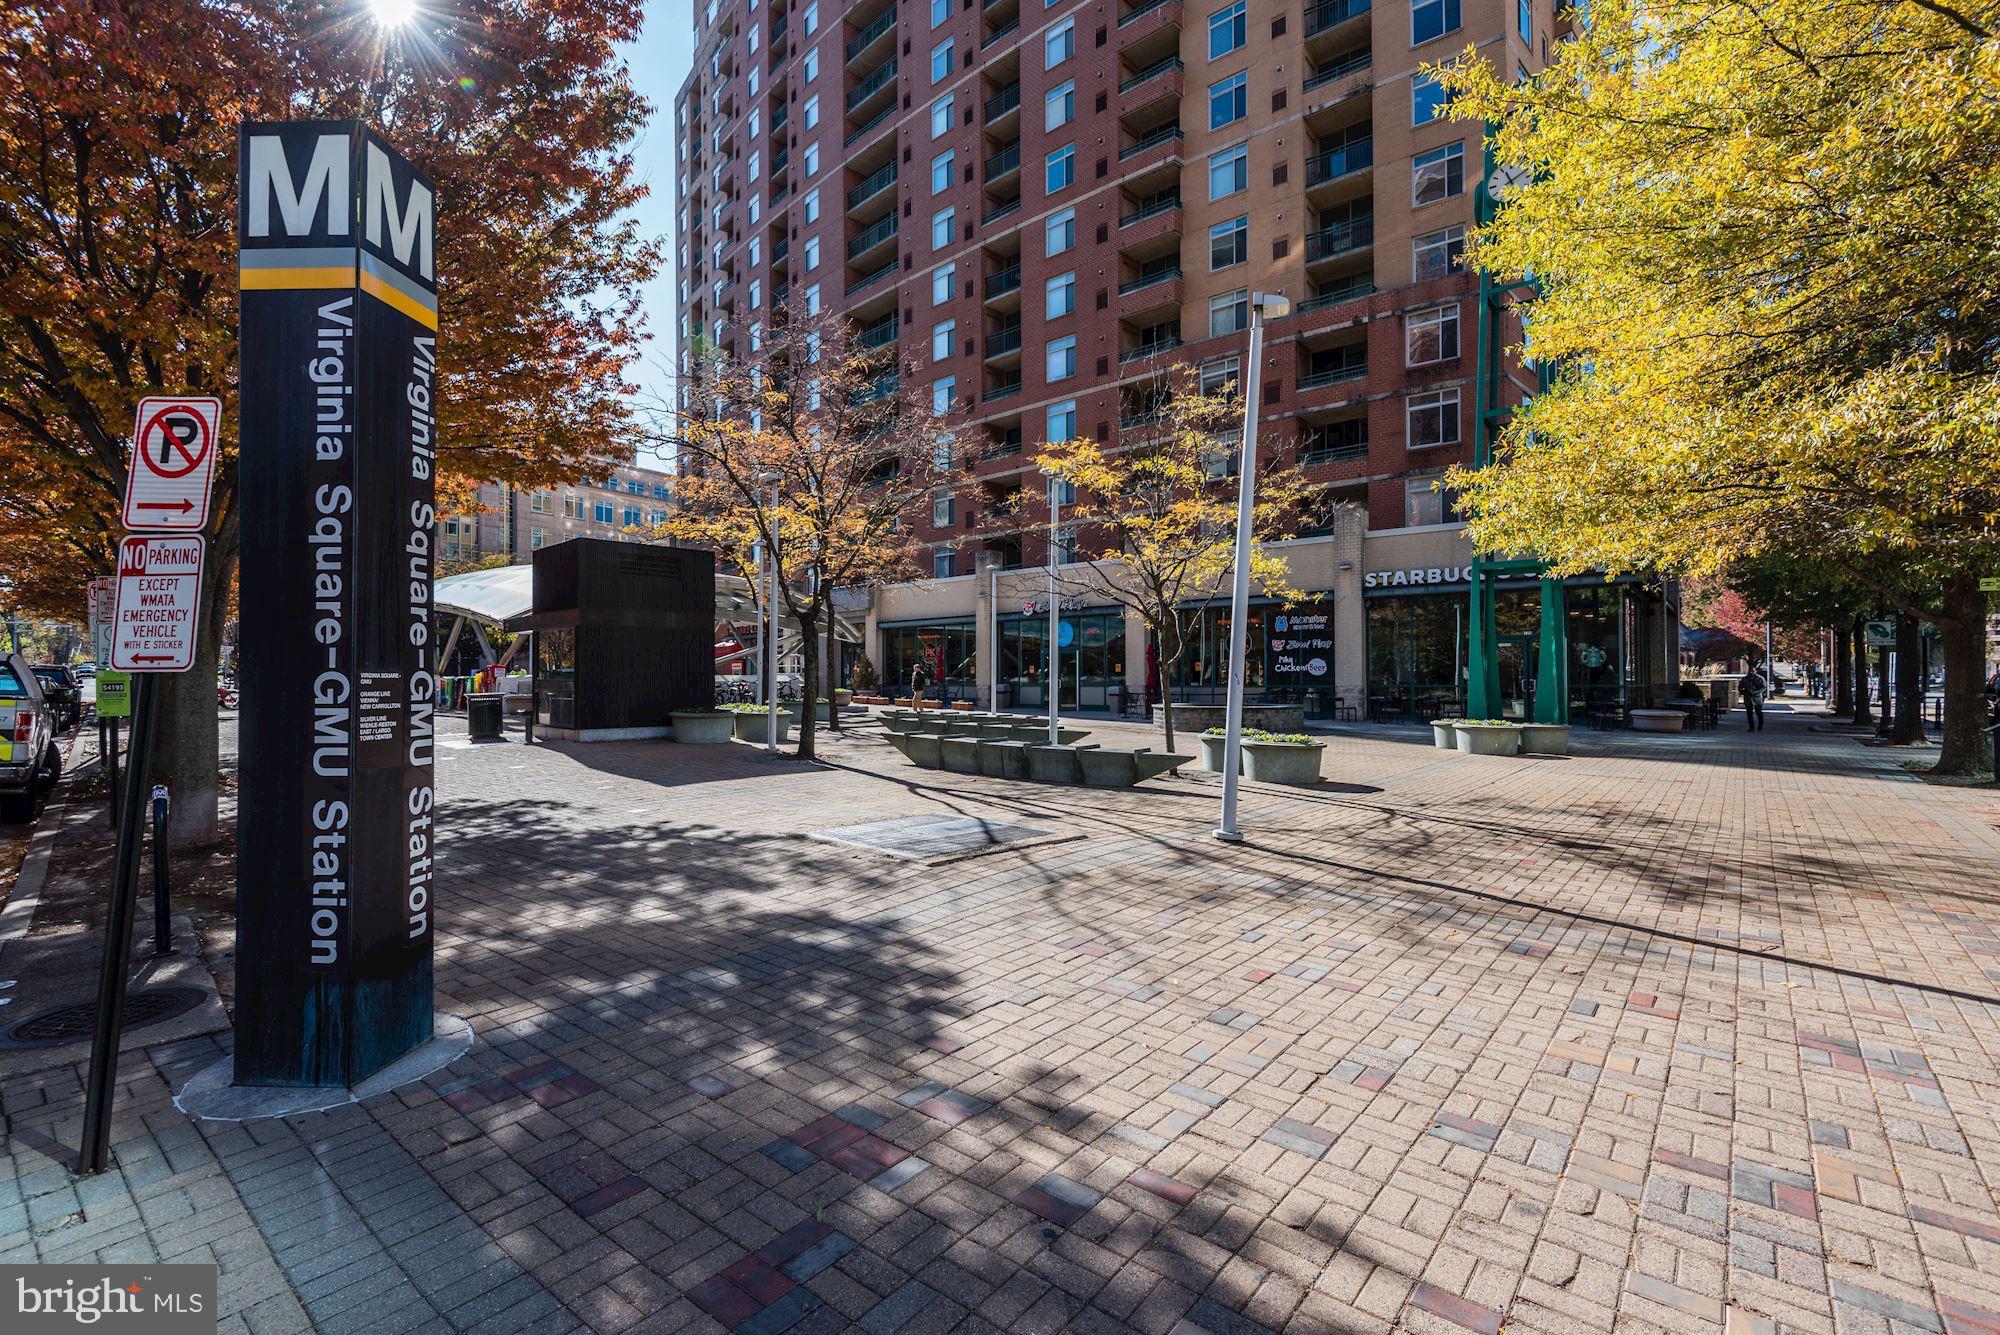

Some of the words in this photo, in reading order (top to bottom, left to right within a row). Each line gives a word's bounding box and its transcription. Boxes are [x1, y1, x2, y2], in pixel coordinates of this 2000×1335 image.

[249, 134, 350, 237] M
[366, 139, 433, 282] M
[308, 296, 353, 461] Virginia
[407, 336, 435, 481] Virginia
[121, 544, 147, 570] NO
[149, 548, 198, 565] PARKING
[138, 579, 180, 591] EXCEPT
[140, 594, 175, 607] WMATA
[123, 609, 189, 622] EMERGENCY
[124, 641, 140, 649] WITH
[153, 641, 183, 649] STICKER
[133, 625, 178, 638] VEHICLE
[308, 483, 352, 777] Square-GMU
[406, 500, 435, 766] Square-GMU
[1290, 615, 1328, 624] Monster
[311, 799, 349, 965] Station
[408, 786, 433, 939] Station
